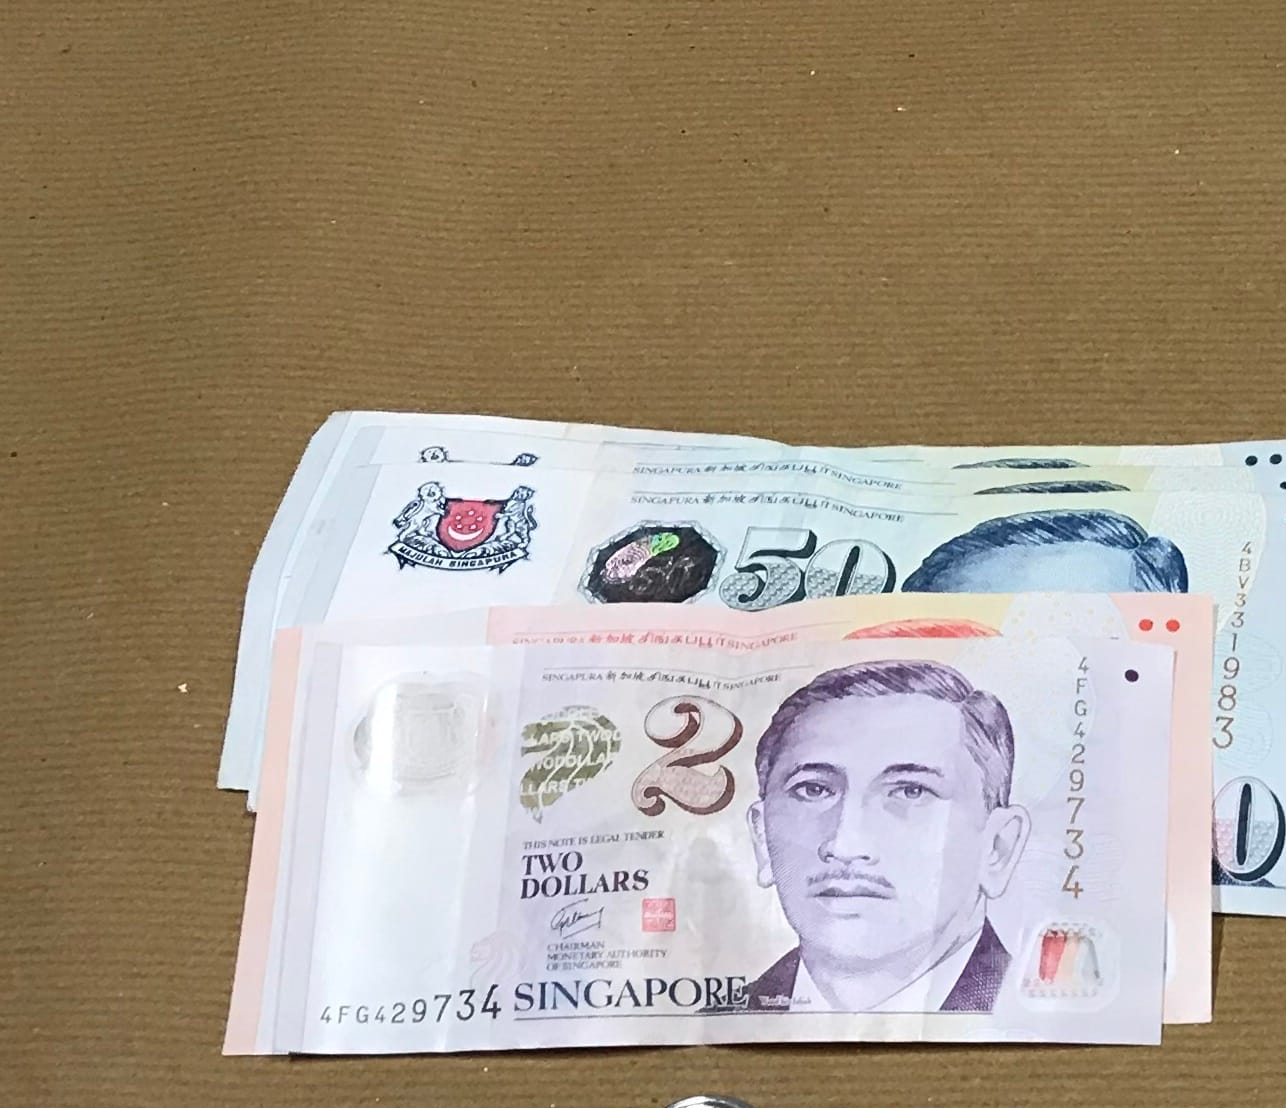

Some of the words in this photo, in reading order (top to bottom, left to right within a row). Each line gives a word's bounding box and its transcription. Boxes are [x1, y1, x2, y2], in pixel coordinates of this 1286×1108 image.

[831, 470, 903, 490] SINGAPORE
[631, 495, 699, 505] SINGAPURA
[831, 502, 905, 523] SINGAPORE
[397, 545, 443, 567] MAJULAH
[448, 551, 519, 568] SINGAPURA
[719, 526, 897, 612] 50
[1212, 541, 1253, 750] 4BV331983
[631, 694, 743, 817] 2
[1061, 656, 1090, 900] 4FG429734
[522, 841, 547, 851] THIS
[548, 838, 576, 848] NOTE
[578, 837, 588, 847] IS
[590, 834, 620, 845] LEGAL
[624, 830, 665, 842] TENDER
[521, 850, 584, 876] TWO
[520, 868, 650, 900] DOLLARS
[546, 951, 604, 962] MONETARY
[319, 983, 502, 1025] 4FG429734
[512, 975, 748, 1013] SINGAPORE
